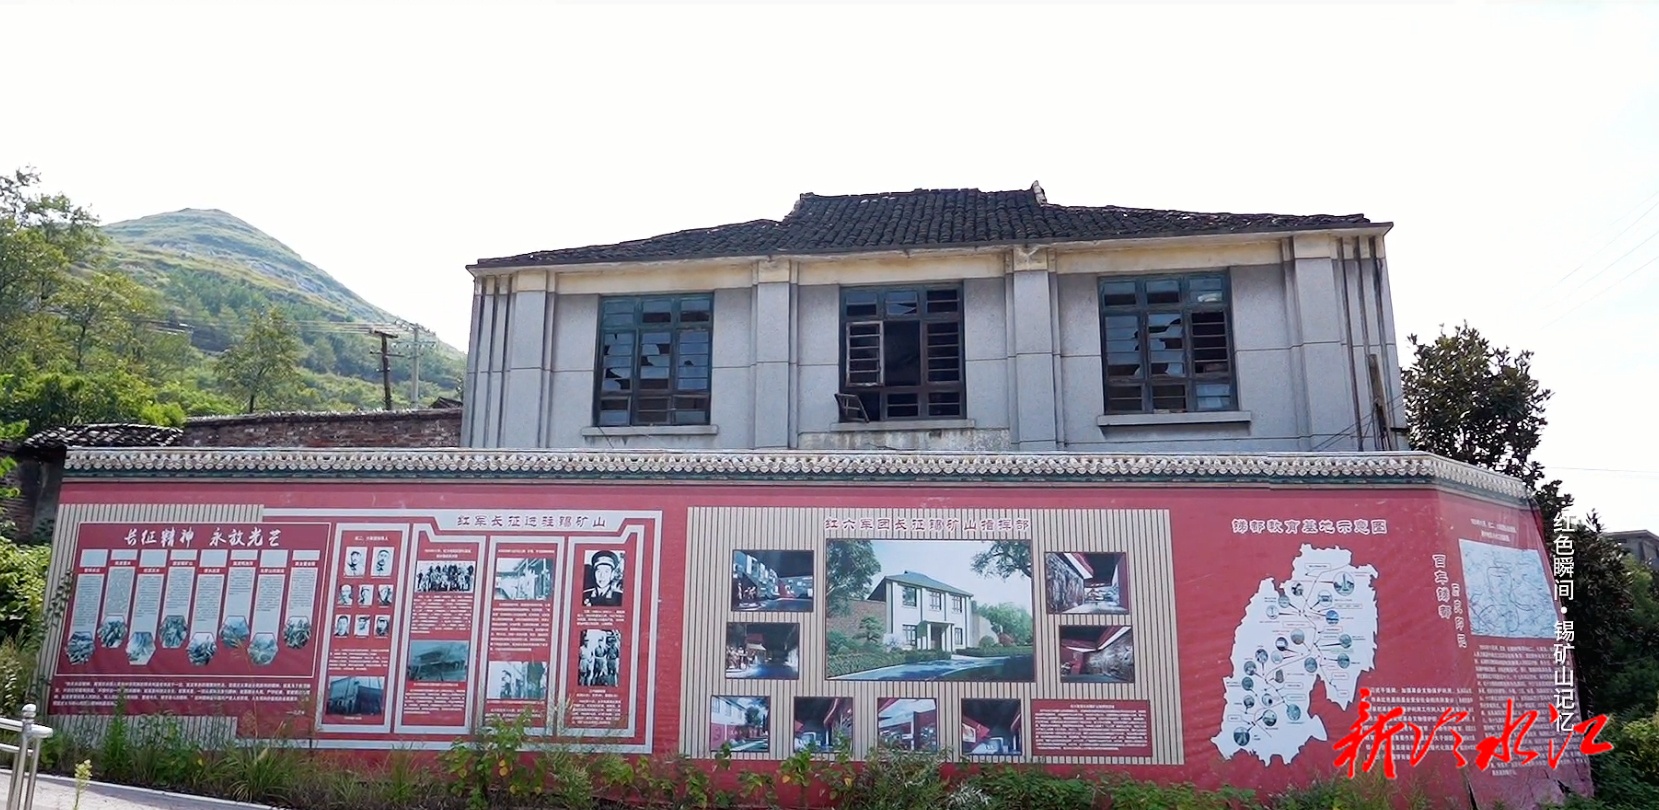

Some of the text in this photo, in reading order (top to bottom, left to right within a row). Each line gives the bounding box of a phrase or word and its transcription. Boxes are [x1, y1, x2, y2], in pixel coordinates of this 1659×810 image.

[124, 526, 282, 548] 长征精神 永放光芒
